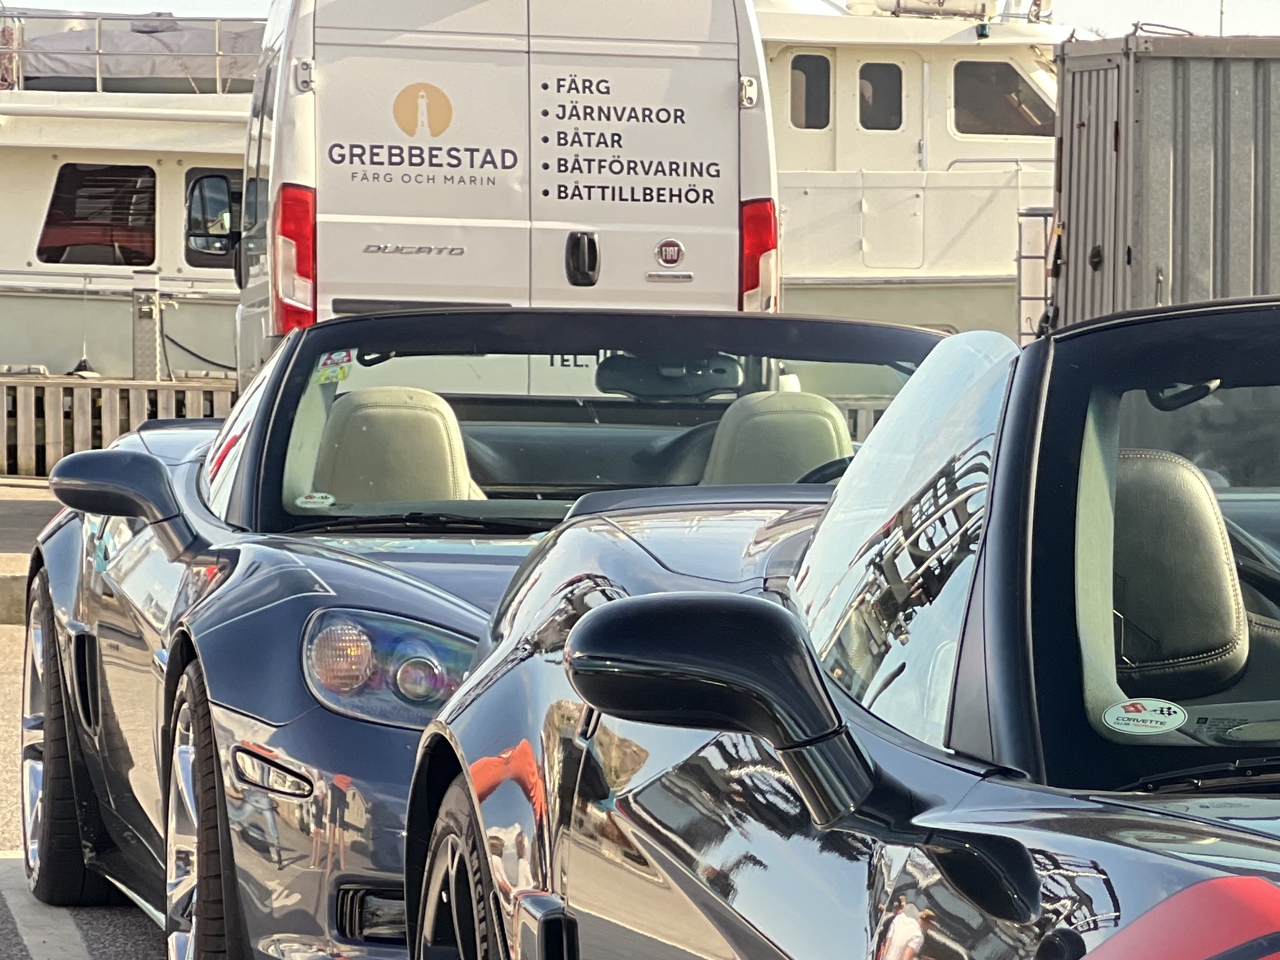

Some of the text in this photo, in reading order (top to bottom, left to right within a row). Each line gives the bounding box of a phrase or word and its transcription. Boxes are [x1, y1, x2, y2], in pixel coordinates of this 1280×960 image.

[556, 74, 611, 95] FÄRG
[555, 100, 686, 124] JÄRNVAROR
[557, 127, 623, 149] BÅTAR
[328, 143, 518, 170] GREBBESTAD
[557, 154, 721, 178] BÅTFÖRVARING
[351, 170, 496, 186] FÄRG OCH MARIN
[557, 180, 715, 204] BÅTTILLBEHÖR
[363, 243, 466, 256] DUCATO
[662, 246, 679, 260] FIAT
[1115, 716, 1167, 726] CORVETTE
